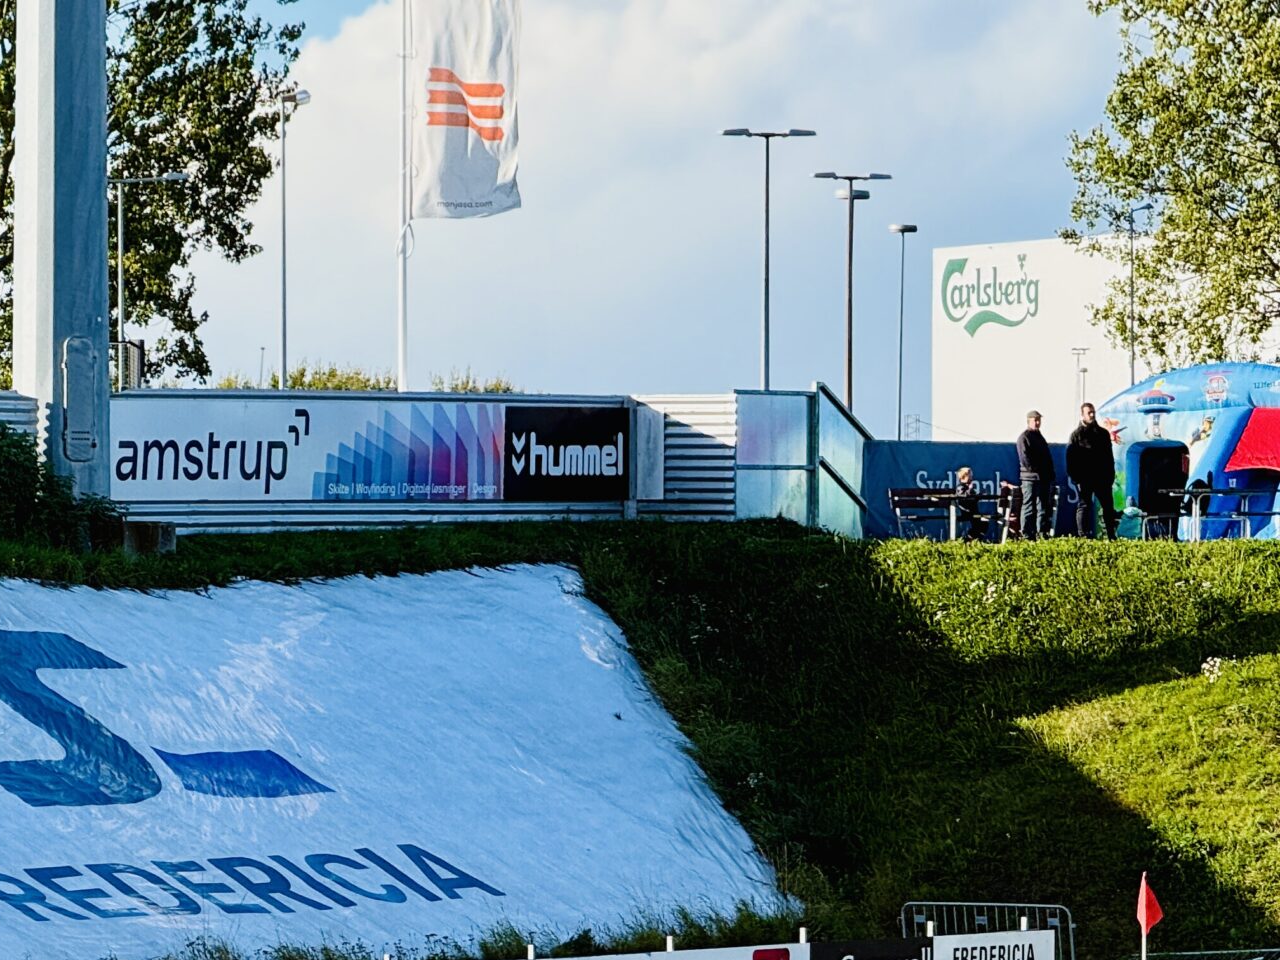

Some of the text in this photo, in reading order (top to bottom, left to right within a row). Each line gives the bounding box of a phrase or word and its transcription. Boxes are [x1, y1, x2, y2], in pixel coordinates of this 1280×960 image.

[941, 256, 1040, 337] Carlsberg
[116, 432, 288, 494] amstrup
[530, 432, 623, 476] hummel
[328, 483, 349, 495] Skilte
[356, 483, 395, 497] Wayfinding
[402, 483, 430, 496] Digitale
[472, 484, 497, 496] Design
